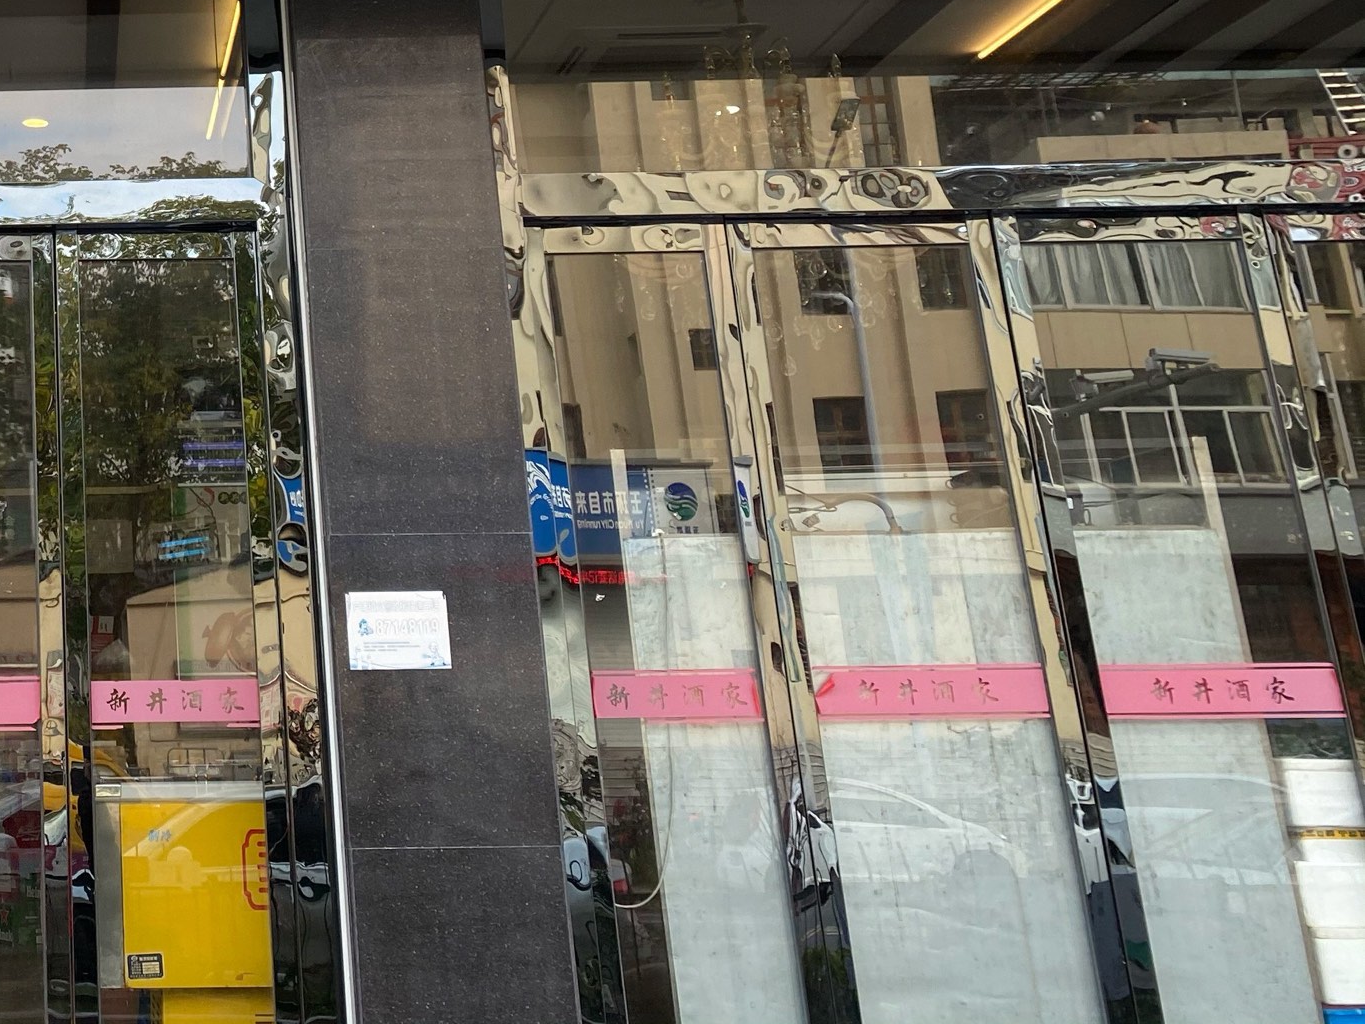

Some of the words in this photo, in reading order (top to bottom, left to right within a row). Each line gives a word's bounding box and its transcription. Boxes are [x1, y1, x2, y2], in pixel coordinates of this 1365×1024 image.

[107, 687, 245, 714] 新井酒家
[606, 684, 749, 711] 新井酒家
[858, 677, 999, 705] 新井酒家
[1149, 676, 1296, 705] 新井酒家
